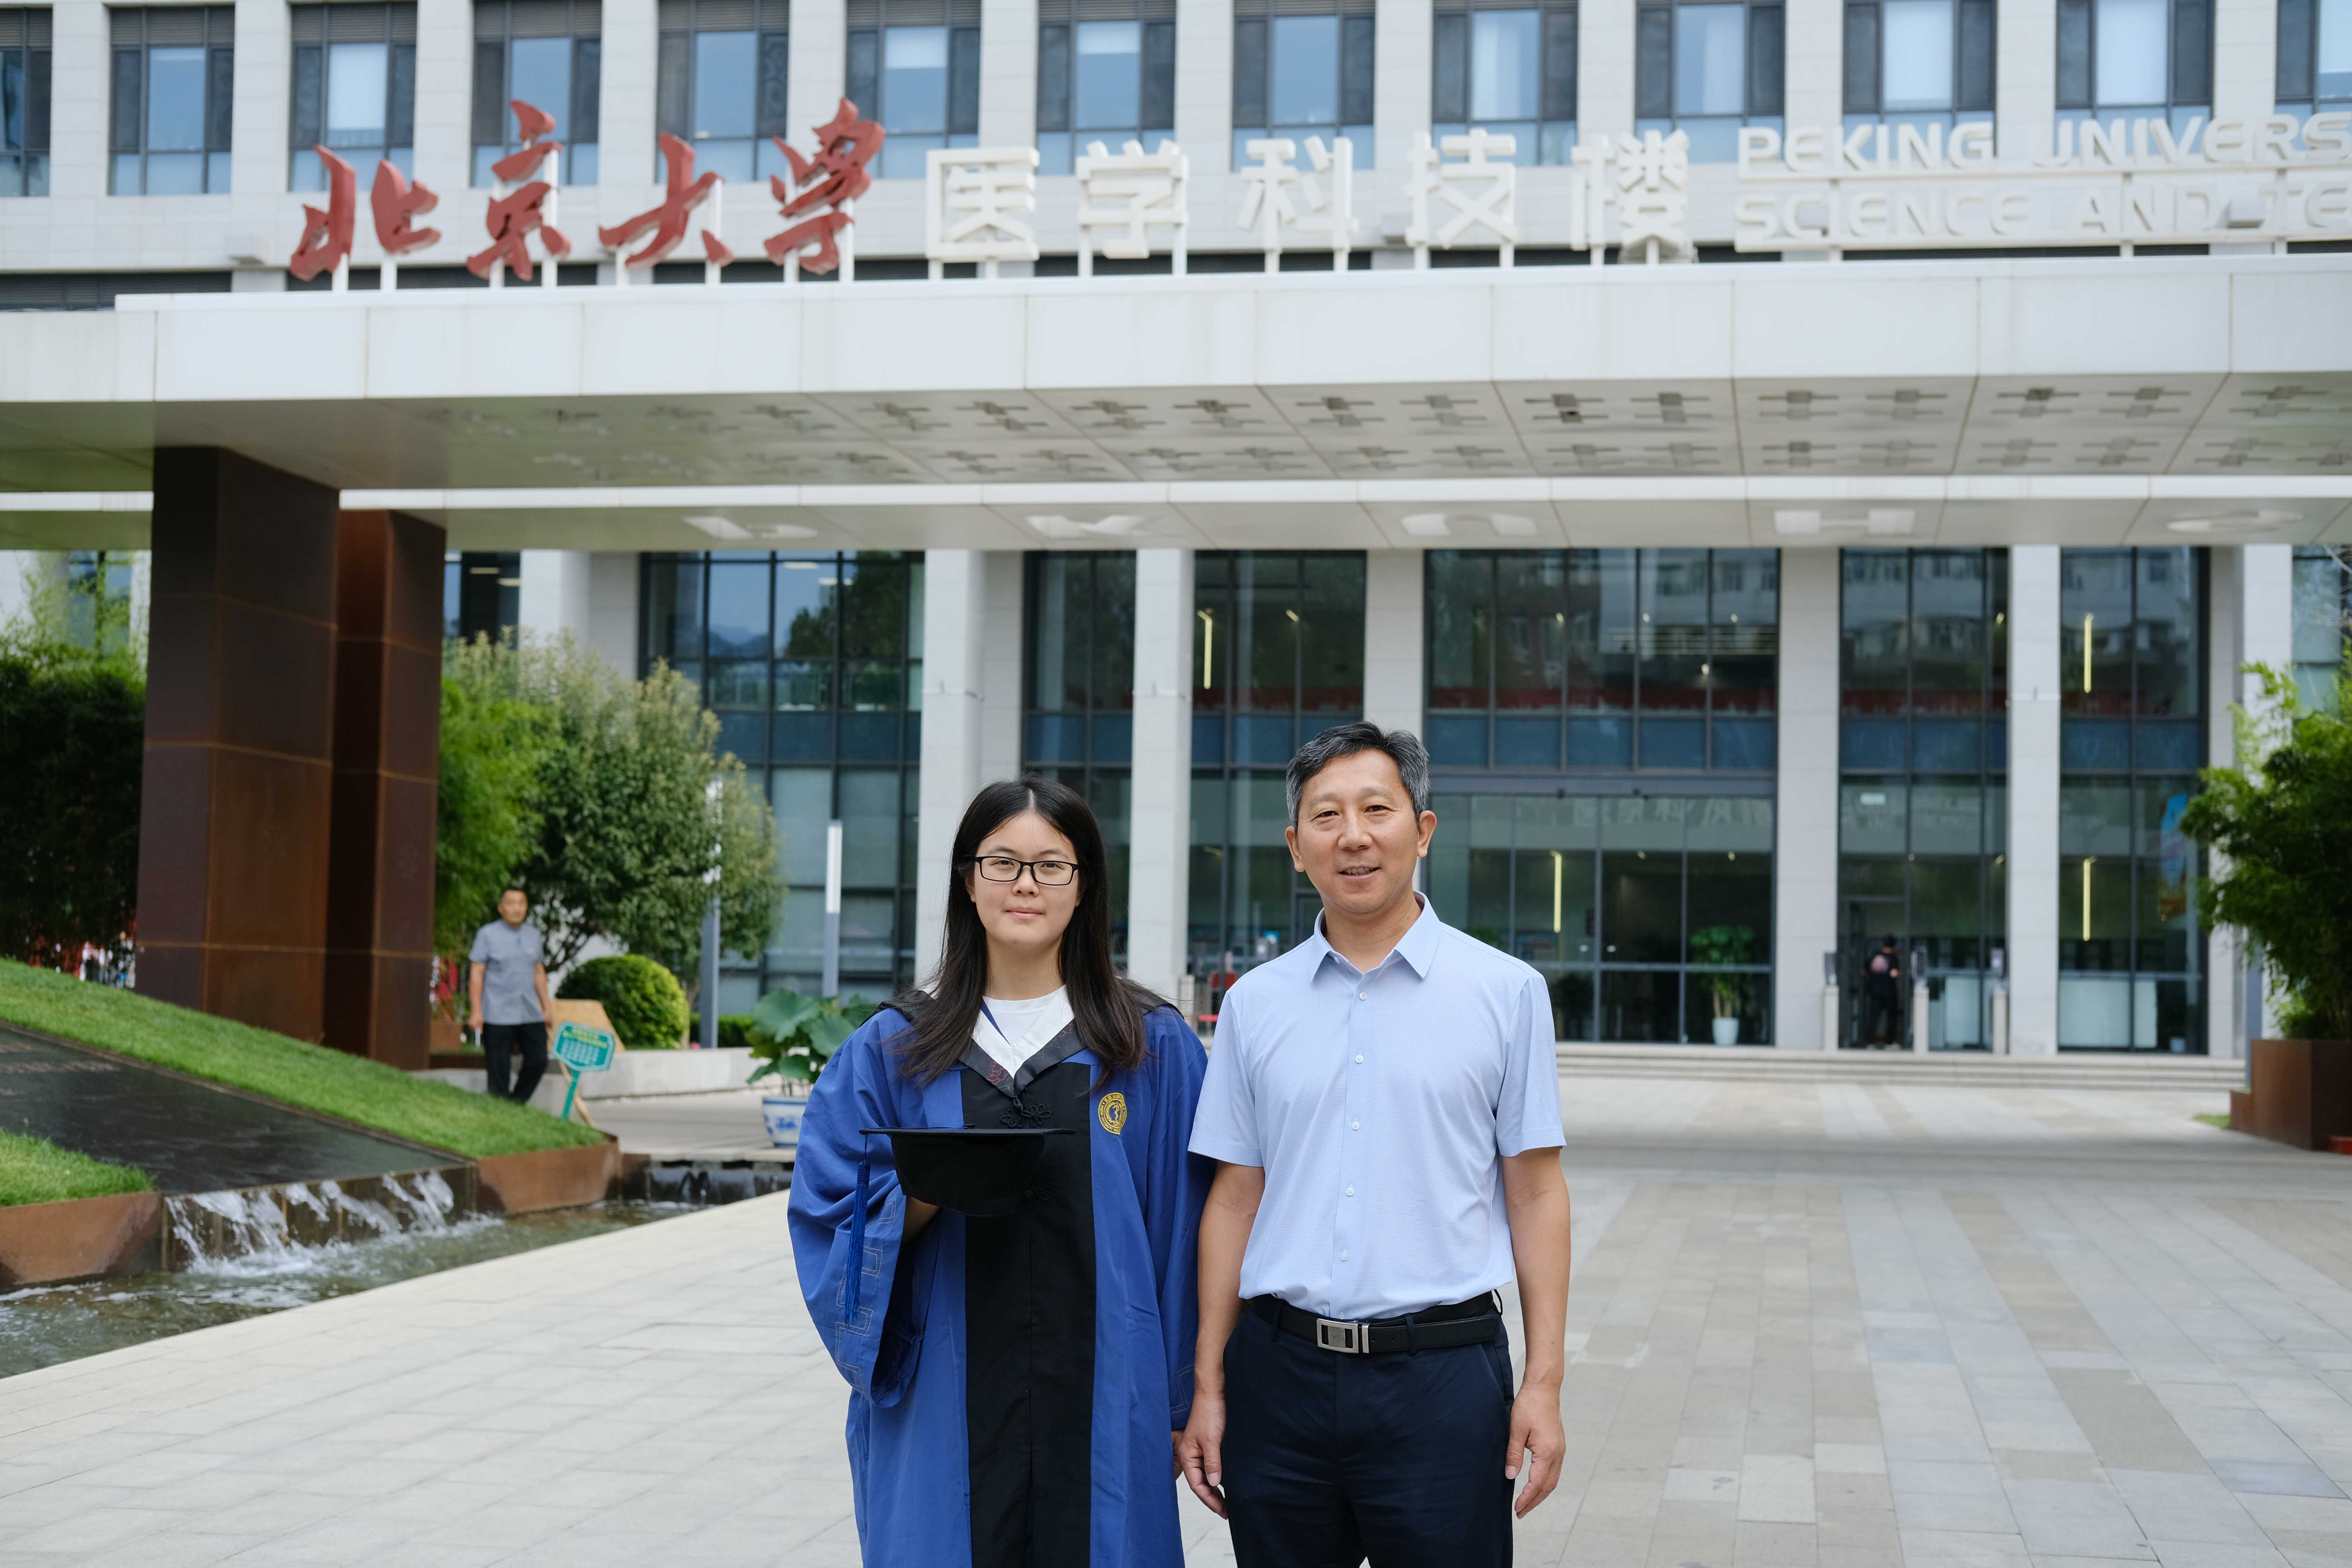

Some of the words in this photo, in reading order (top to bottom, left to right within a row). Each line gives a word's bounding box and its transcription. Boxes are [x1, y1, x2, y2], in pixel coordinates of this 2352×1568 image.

[1738, 122, 1995, 173] PEKING
[2029, 112, 2352, 167] UNIVERS
[925, 128, 1691, 261] 医学科技楼
[1735, 189, 2031, 239] SCIENCE
[2074, 185, 2221, 233] AND
